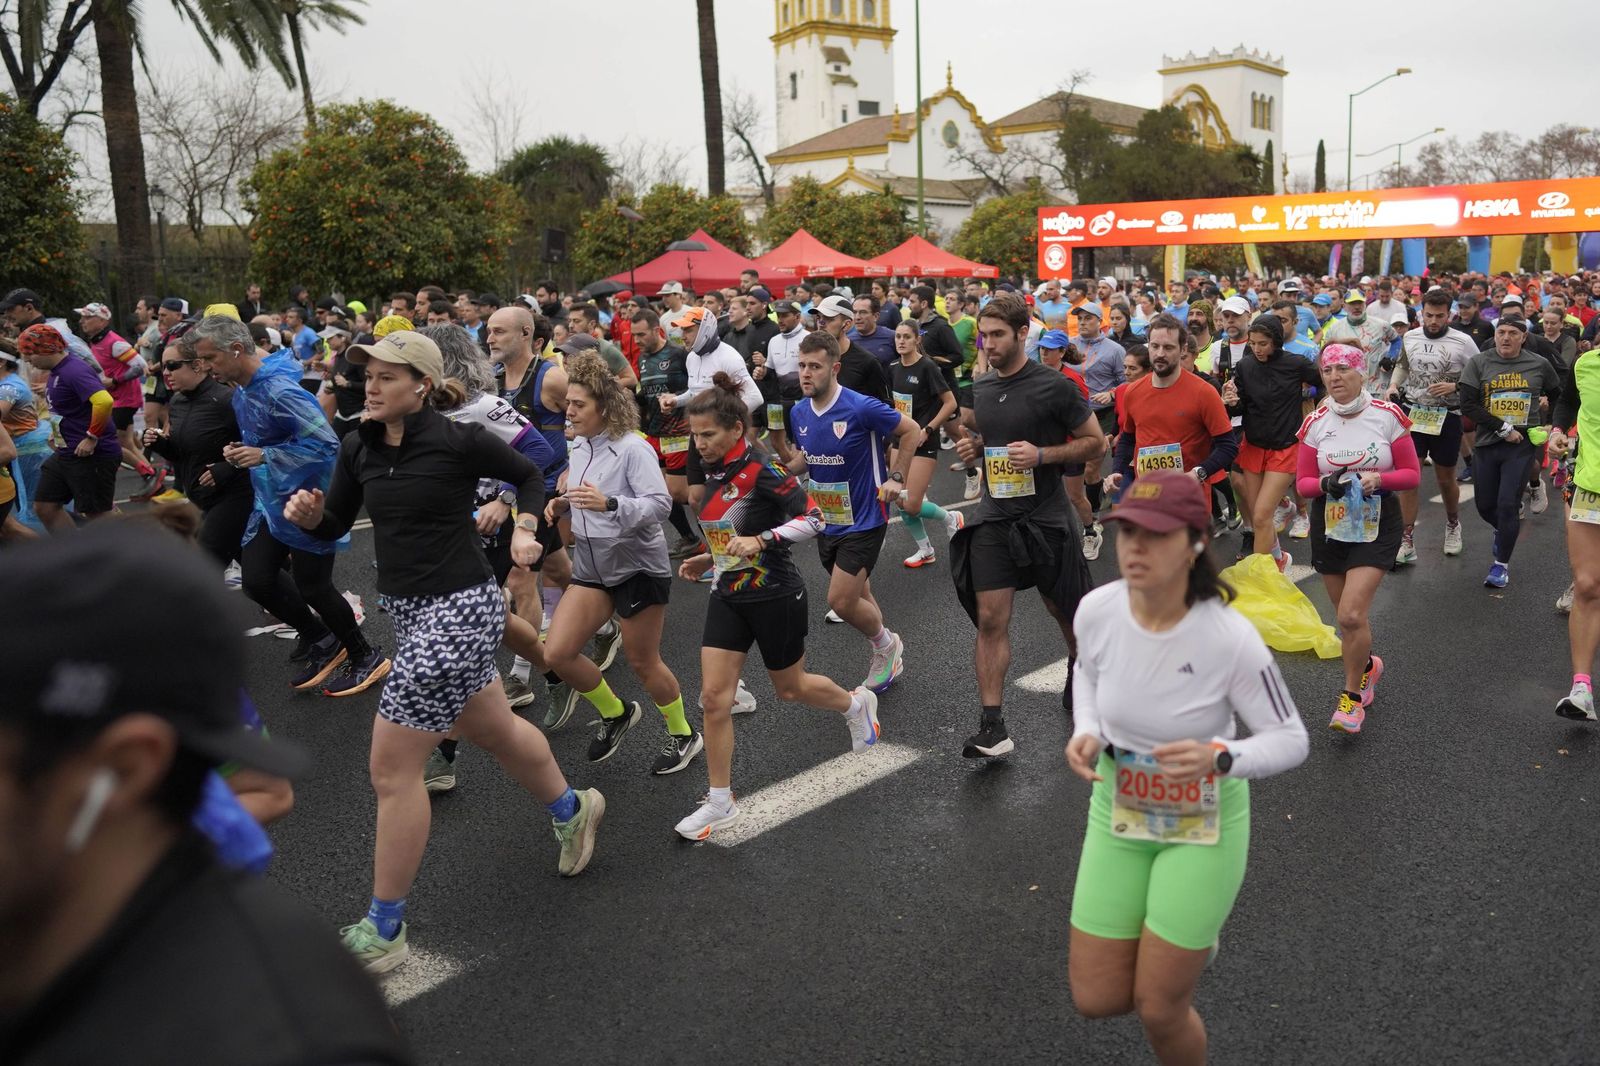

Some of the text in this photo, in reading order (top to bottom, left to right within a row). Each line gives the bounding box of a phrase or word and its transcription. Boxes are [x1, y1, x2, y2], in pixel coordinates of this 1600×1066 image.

[1463, 198, 1522, 218] HOKA
[1491, 380, 1529, 389] SABINA
[1494, 400, 1525, 411] 15290
[988, 460, 1023, 475] 1549
[1140, 456, 1175, 472] 14363
[1580, 490, 1600, 504] 10
[1120, 768, 1200, 804] 20558
